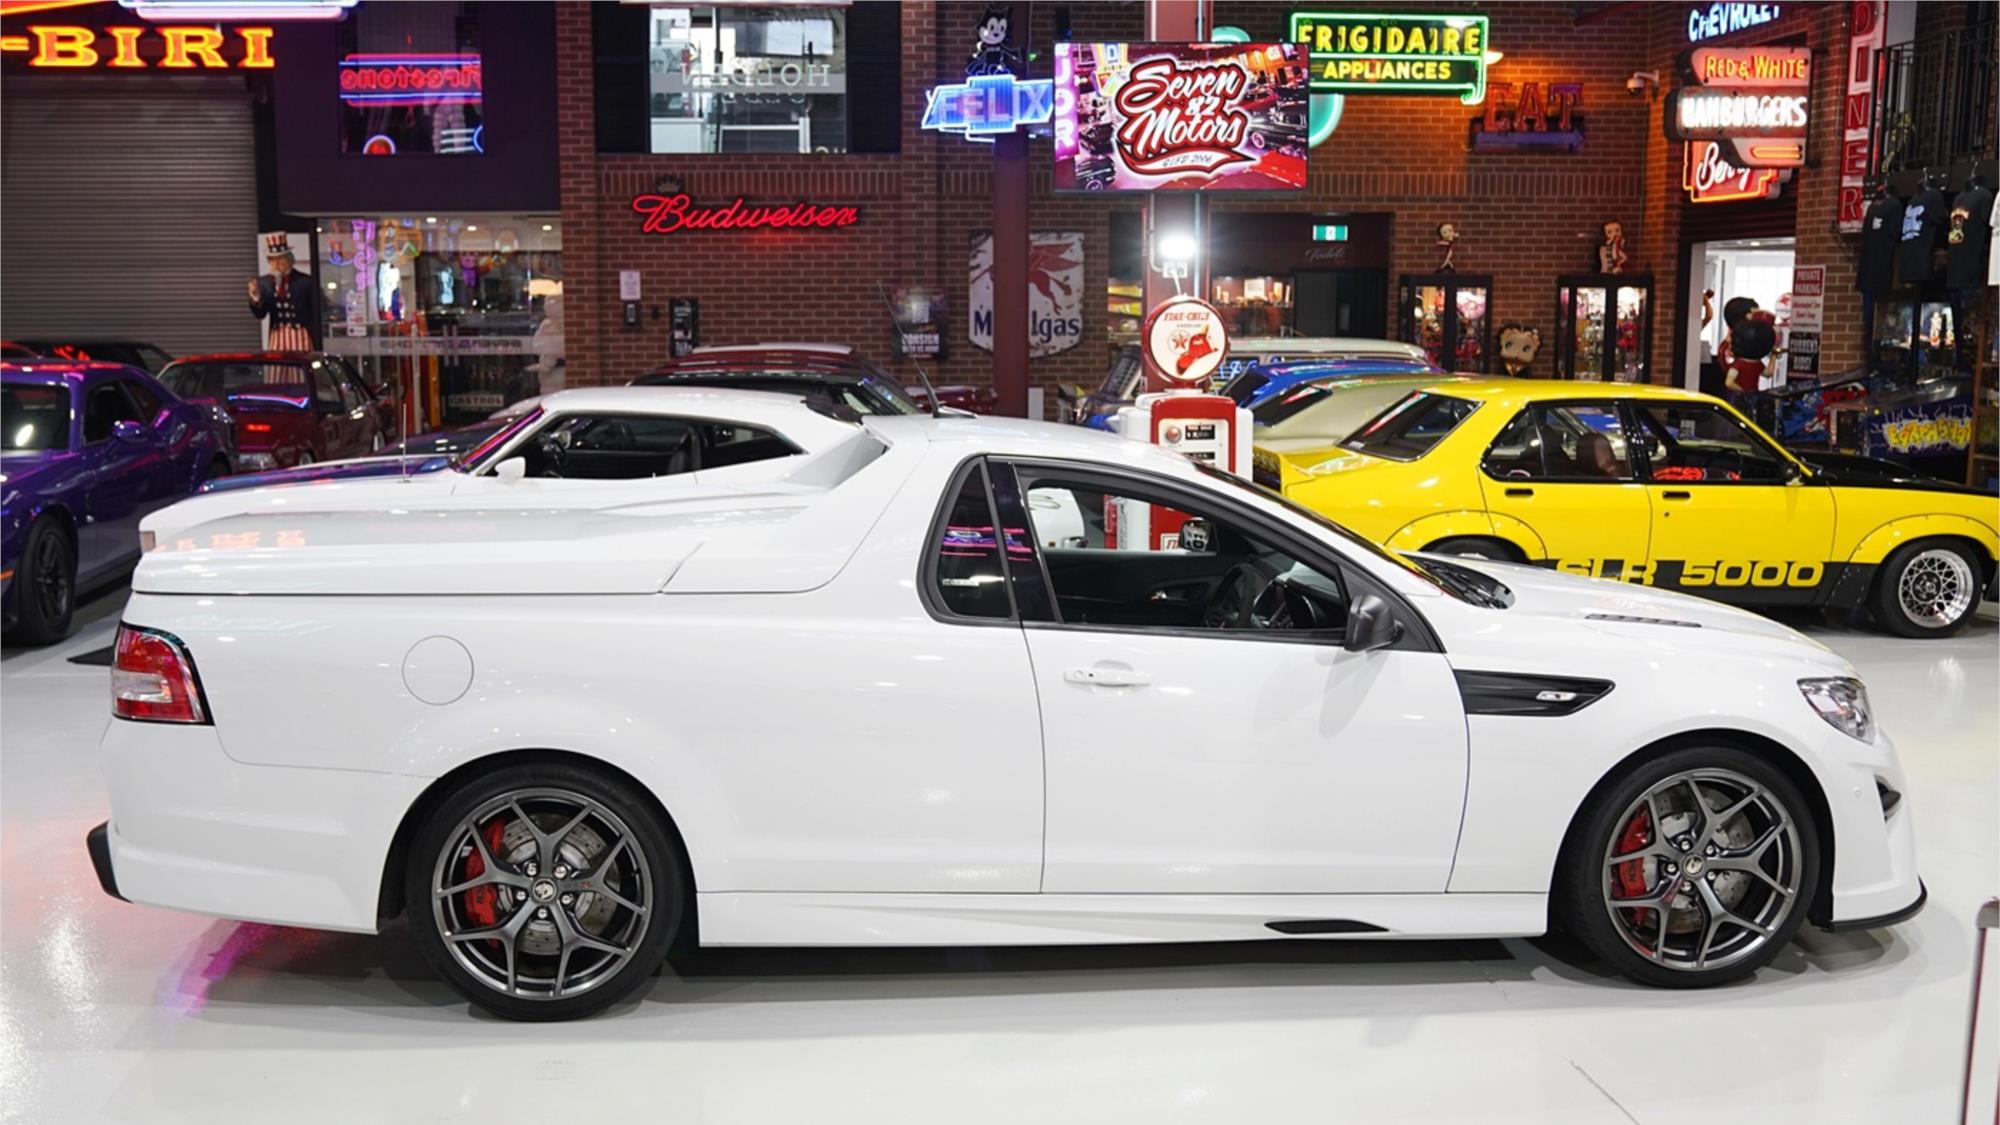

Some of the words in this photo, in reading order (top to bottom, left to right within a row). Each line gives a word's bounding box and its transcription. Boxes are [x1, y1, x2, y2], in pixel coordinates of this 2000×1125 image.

[1298, 24, 1481, 54] FRIGIDAIRE
[1323, 61, 1451, 80] APPLIANCES
[1706, 56, 1736, 78] RED
[1739, 60, 1750, 80] &
[1754, 55, 1806, 78] WHITE
[939, 85, 1050, 124] FELIX
[1121, 63, 1242, 114] Seven
[1185, 95, 1221, 117] 82
[1483, 82, 1583, 132] EAT
[1681, 95, 1808, 128] HAMBURGERS
[1840, 2, 1873, 219] DINER
[1123, 107, 1243, 155] Motors
[631, 194, 858, 233] Budweiser
[973, 310, 1081, 344] Mlgas
[1557, 559, 1658, 586] SLR
[1679, 561, 1825, 588] 5000
